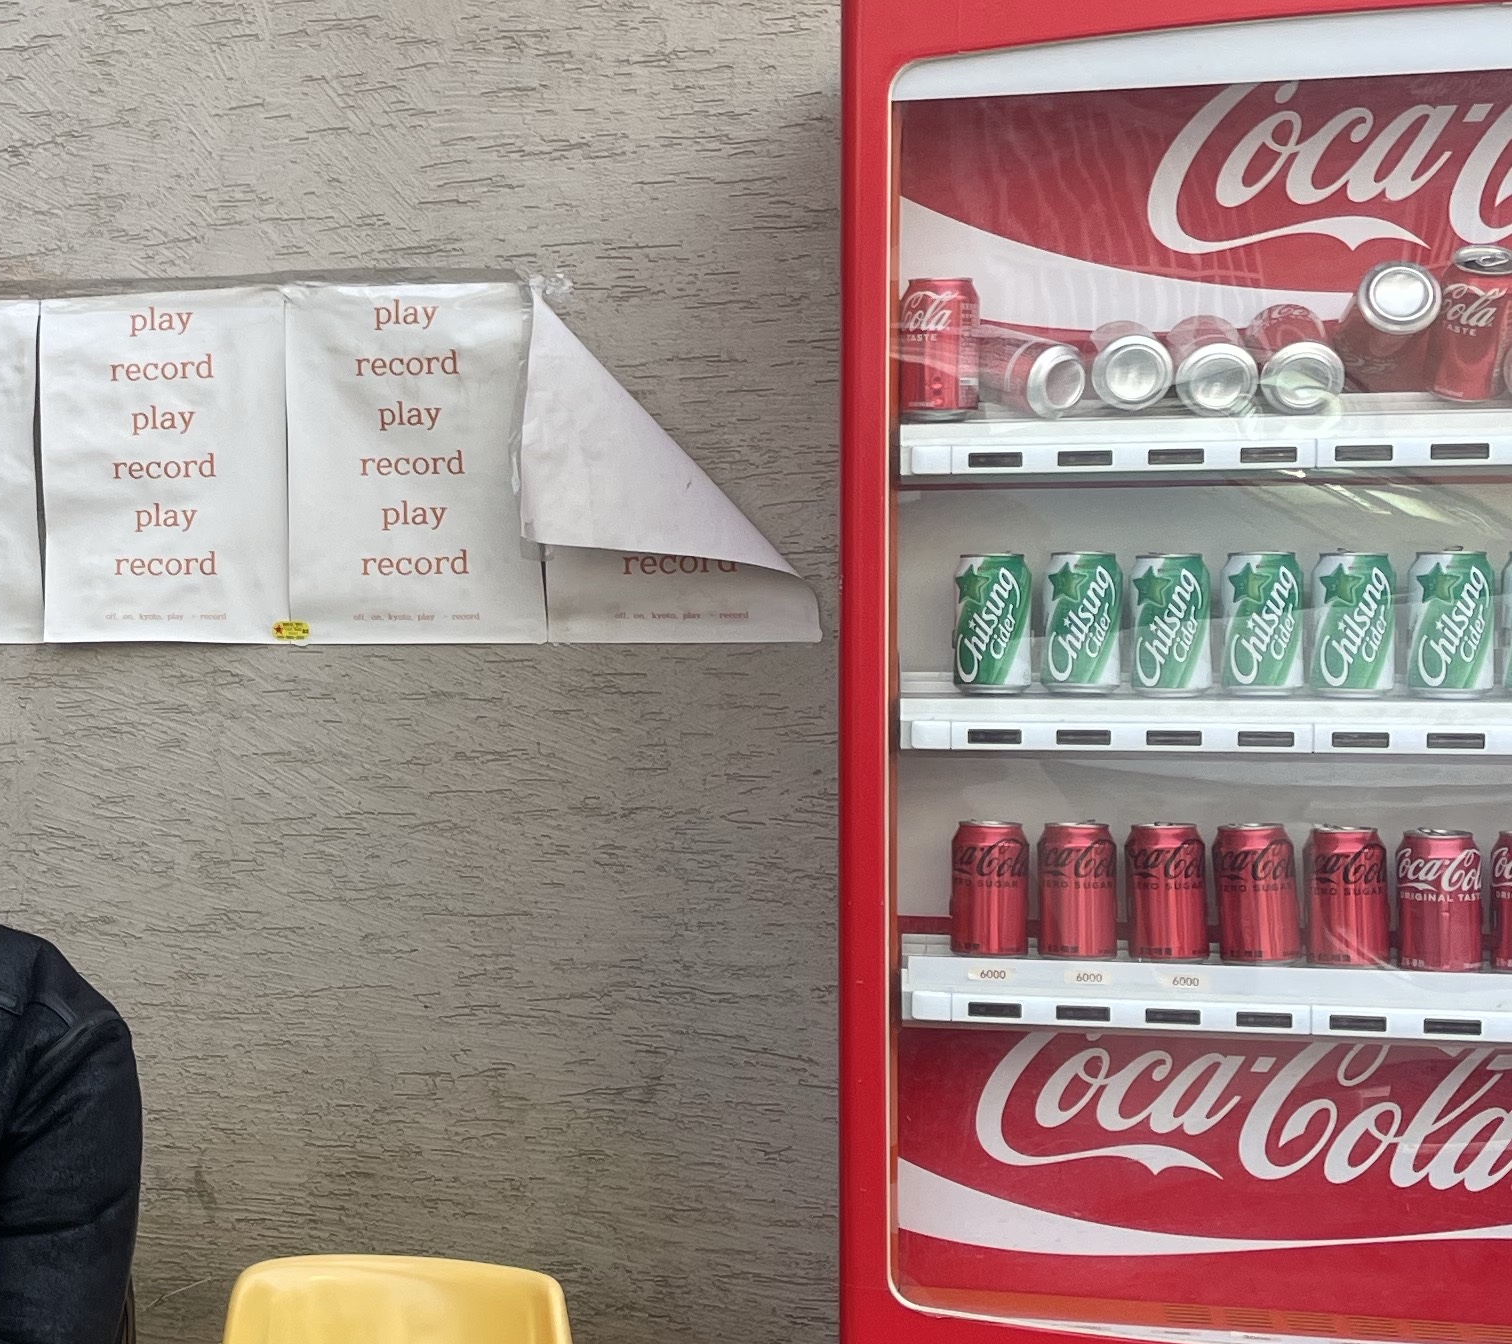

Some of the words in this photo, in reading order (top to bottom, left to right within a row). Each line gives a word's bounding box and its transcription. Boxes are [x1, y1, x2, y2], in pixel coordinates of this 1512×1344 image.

[130, 306, 194, 338] play
[374, 299, 438, 333] play
[109, 352, 216, 383] record
[355, 350, 461, 377] record
[131, 404, 197, 437] play
[378, 400, 442, 433] play
[113, 452, 218, 482] record
[360, 449, 466, 477] record
[135, 503, 199, 533] play
[380, 500, 449, 533] play
[115, 551, 218, 578] record
[361, 548, 471, 578] record
[957, 566, 1021, 683] Chilsung
[990, 603, 1016, 660] Cider
[1048, 565, 1116, 681] Chilsung
[1086, 602, 1111, 658] Cider
[1136, 568, 1203, 687] Chilsung
[1173, 605, 1198, 663] Cider
[1230, 565, 1299, 685] Chilsung
[1270, 603, 1295, 660] Cider
[1320, 566, 1392, 687] Chilsung
[1361, 604, 1387, 663] Cider
[1417, 565, 1489, 687] Chilsung
[1460, 603, 1485, 663] Cider
[1074, 880, 1113, 890] SUGAR
[980, 969, 1006, 980] 6000
[1076, 972, 1103, 983] 6000
[1172, 976, 1200, 987] 6000
